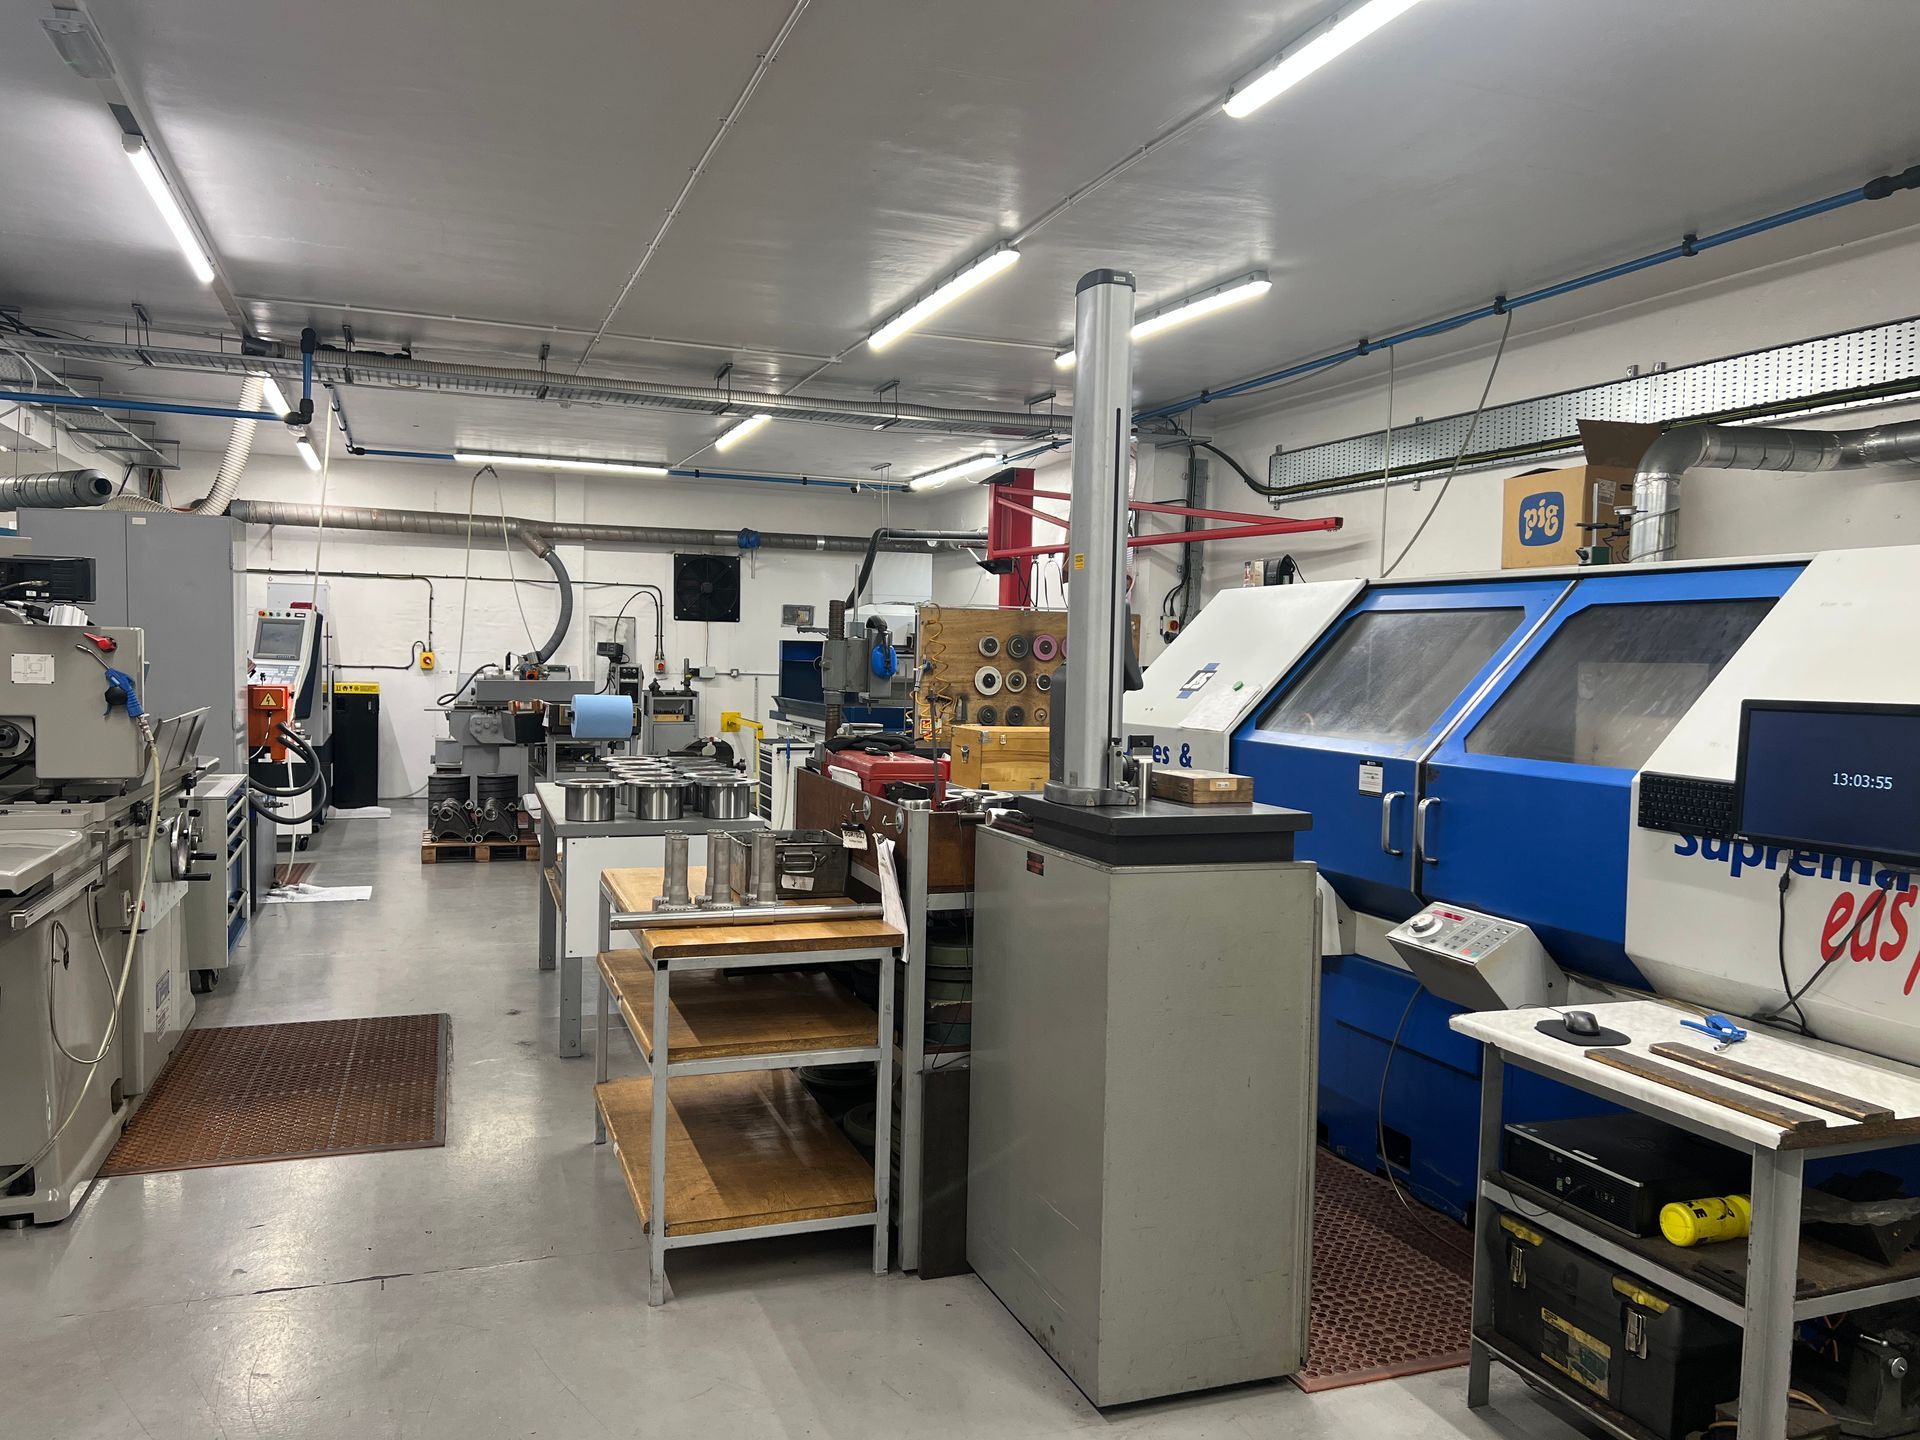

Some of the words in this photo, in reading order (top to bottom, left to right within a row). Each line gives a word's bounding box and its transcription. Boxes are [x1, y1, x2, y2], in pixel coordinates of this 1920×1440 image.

[1523, 499, 1560, 541] pig
[1179, 743, 1192, 768] &
[1832, 772, 1893, 790] 13:03:55
[1820, 885, 1920, 996] eas
